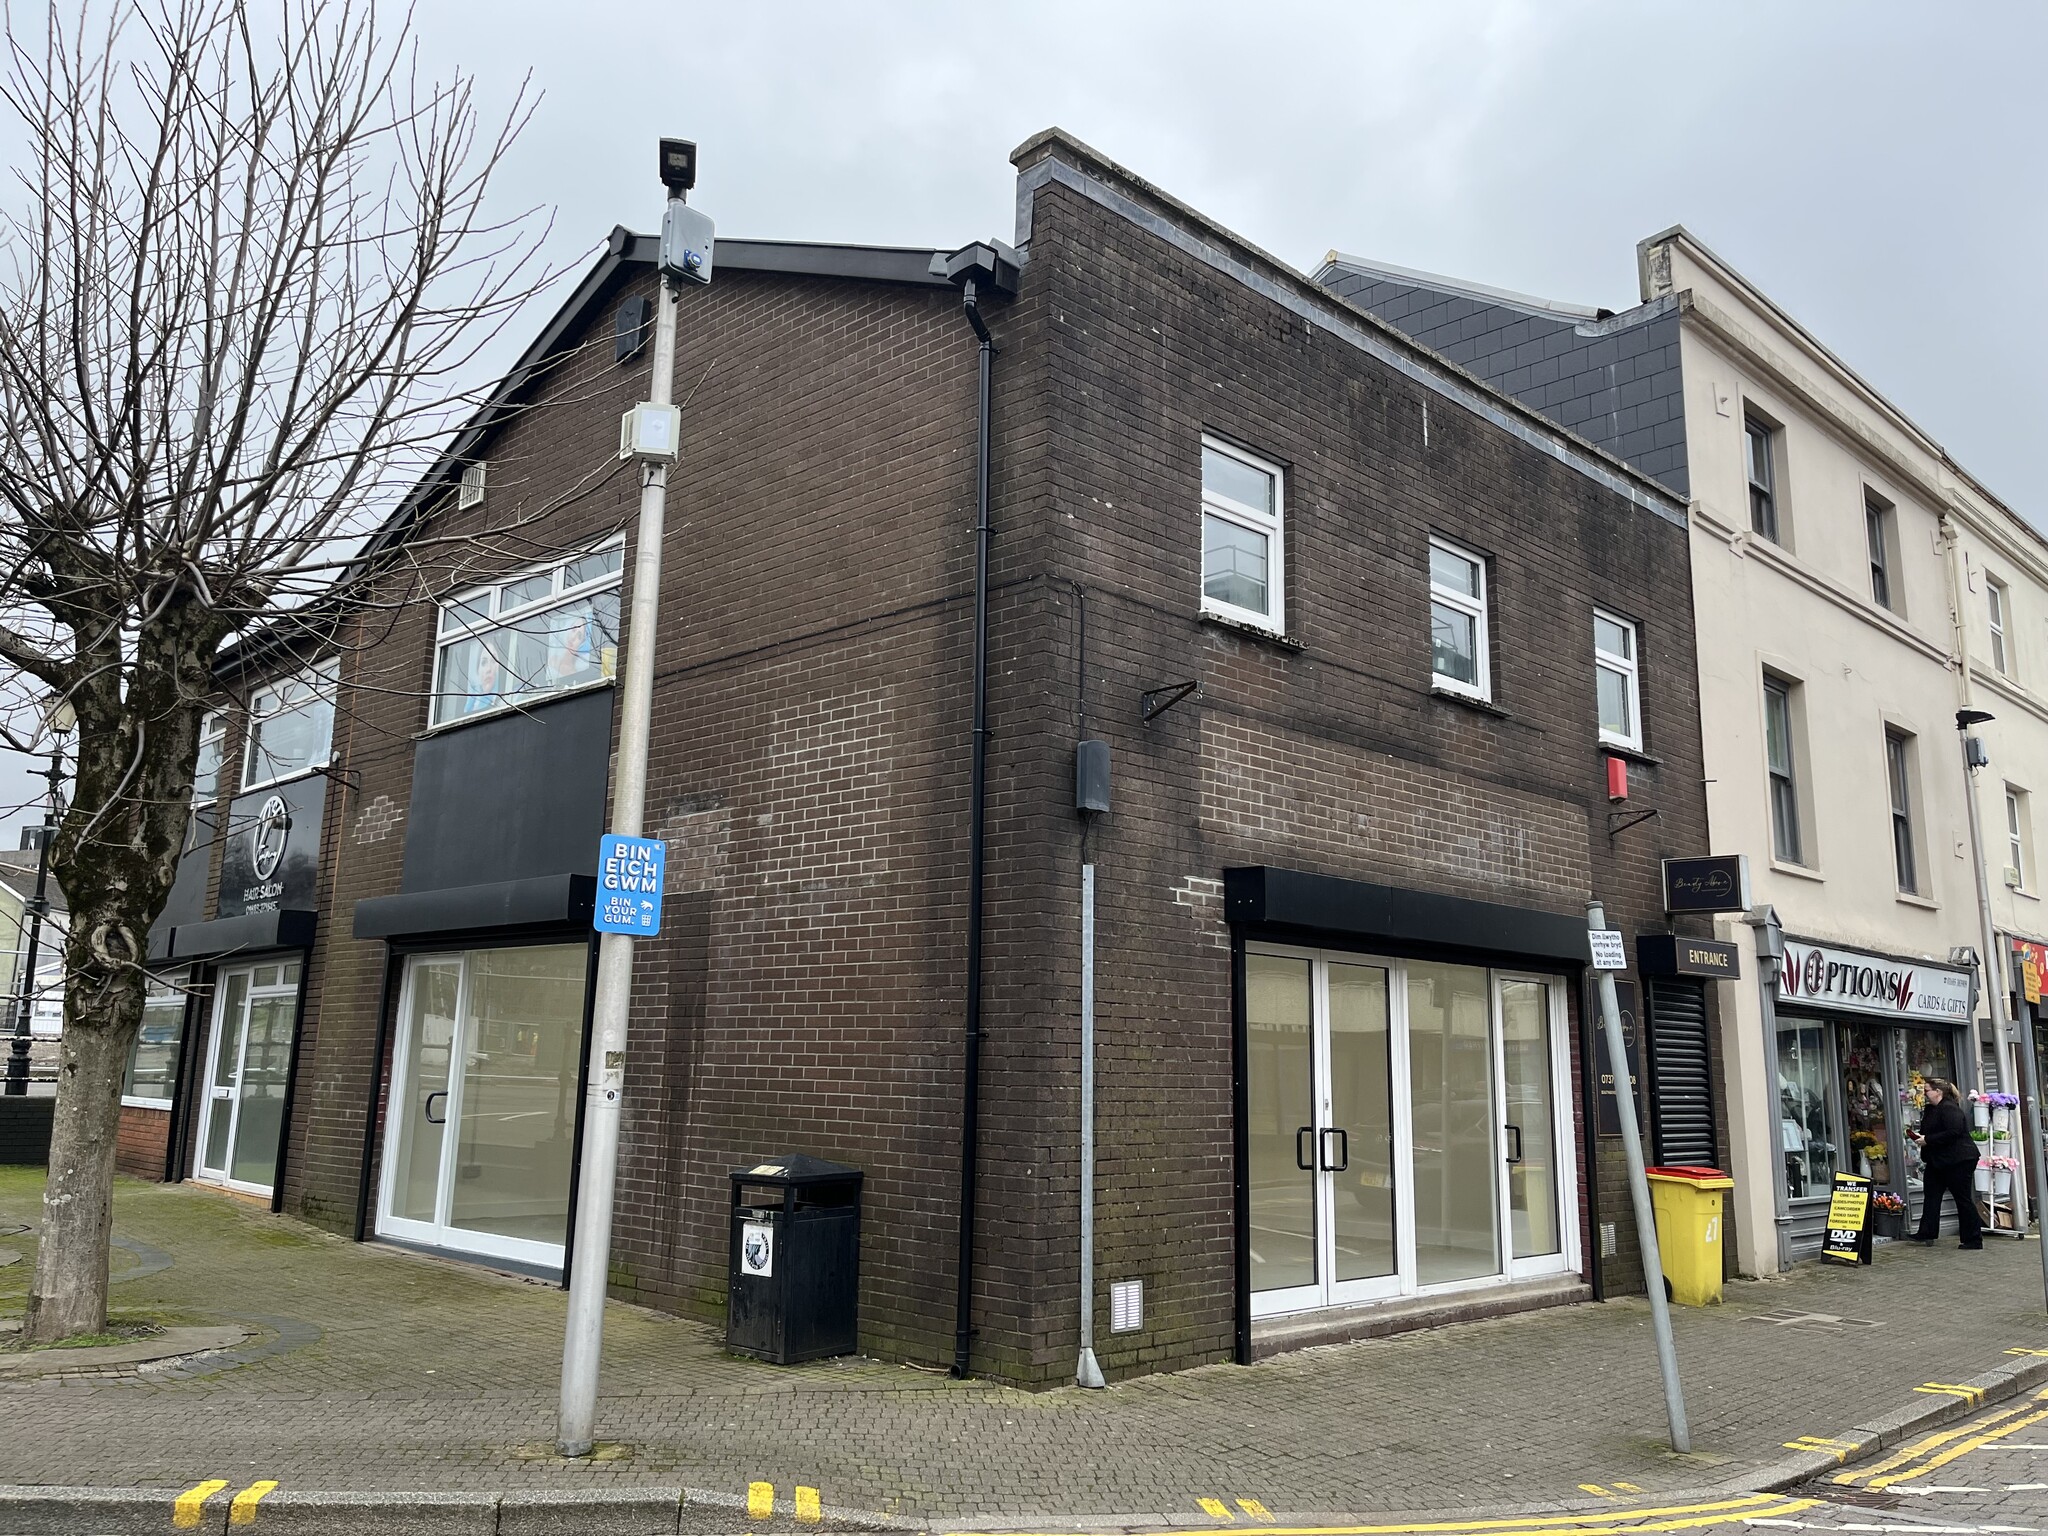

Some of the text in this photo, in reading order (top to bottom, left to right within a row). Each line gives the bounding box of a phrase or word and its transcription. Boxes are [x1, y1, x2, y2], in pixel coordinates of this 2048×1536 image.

[614, 843, 651, 861] BIN
[605, 858, 657, 878] EICH
[260, 881, 283, 899] SALON
[604, 874, 657, 893] GWM
[604, 905, 637, 916] YOUR
[610, 896, 631, 907] BIN
[604, 914, 635, 925] GUM.
[1689, 949, 1729, 967] ENTRANCE
[1917, 993, 1967, 1015] CARDS & GIFTS
[1831, 1230, 1856, 1238] DVD
